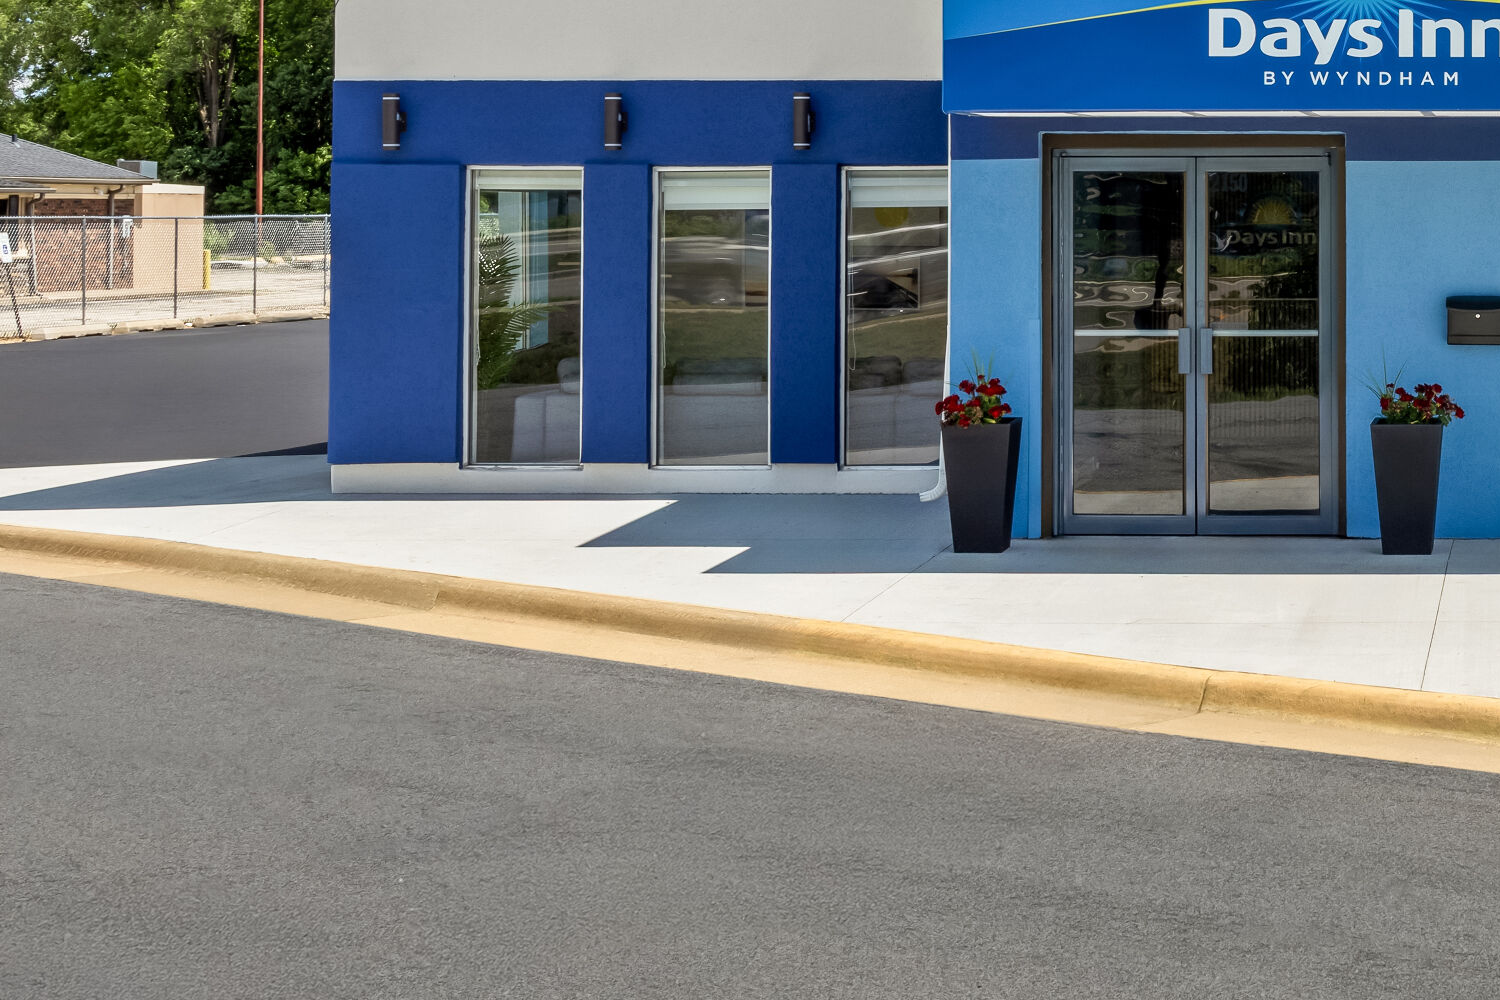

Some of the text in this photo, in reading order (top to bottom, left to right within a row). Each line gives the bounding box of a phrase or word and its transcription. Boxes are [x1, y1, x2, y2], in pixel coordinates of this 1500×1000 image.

[1208, 8, 1384, 65] Days
[1263, 71, 1460, 86] BY WYNDHAM
[1225, 229, 1317, 247] Days Inn
